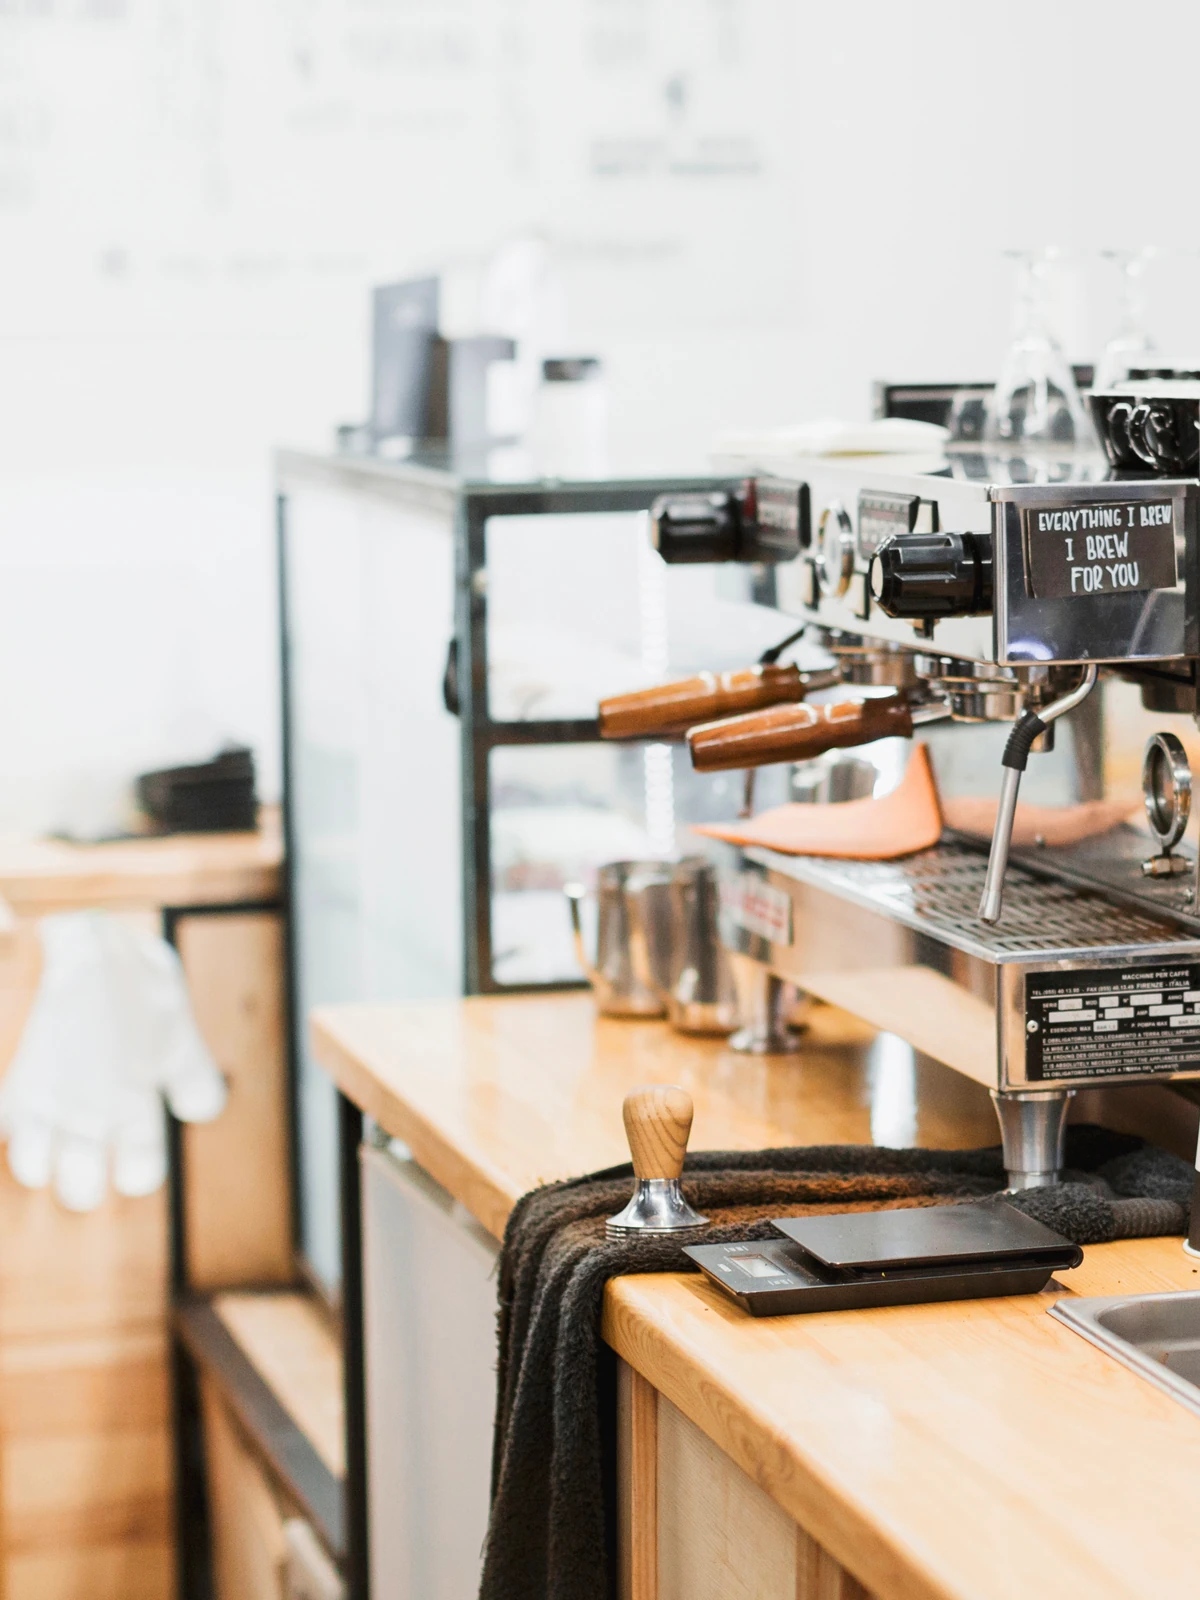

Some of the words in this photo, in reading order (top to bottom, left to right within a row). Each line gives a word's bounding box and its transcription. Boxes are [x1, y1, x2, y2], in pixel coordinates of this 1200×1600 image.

[1038, 507, 1122, 532] EVERYTHING
[1127, 507, 1135, 527] I
[1140, 505, 1172, 527] BREW
[1065, 538, 1075, 561] I
[1086, 531, 1129, 561] BREW
[1071, 565, 1103, 593] FOR
[1105, 561, 1139, 589] YOU
[1122, 972, 1154, 980] MACCHINE
[1155, 971, 1168, 979] PER
